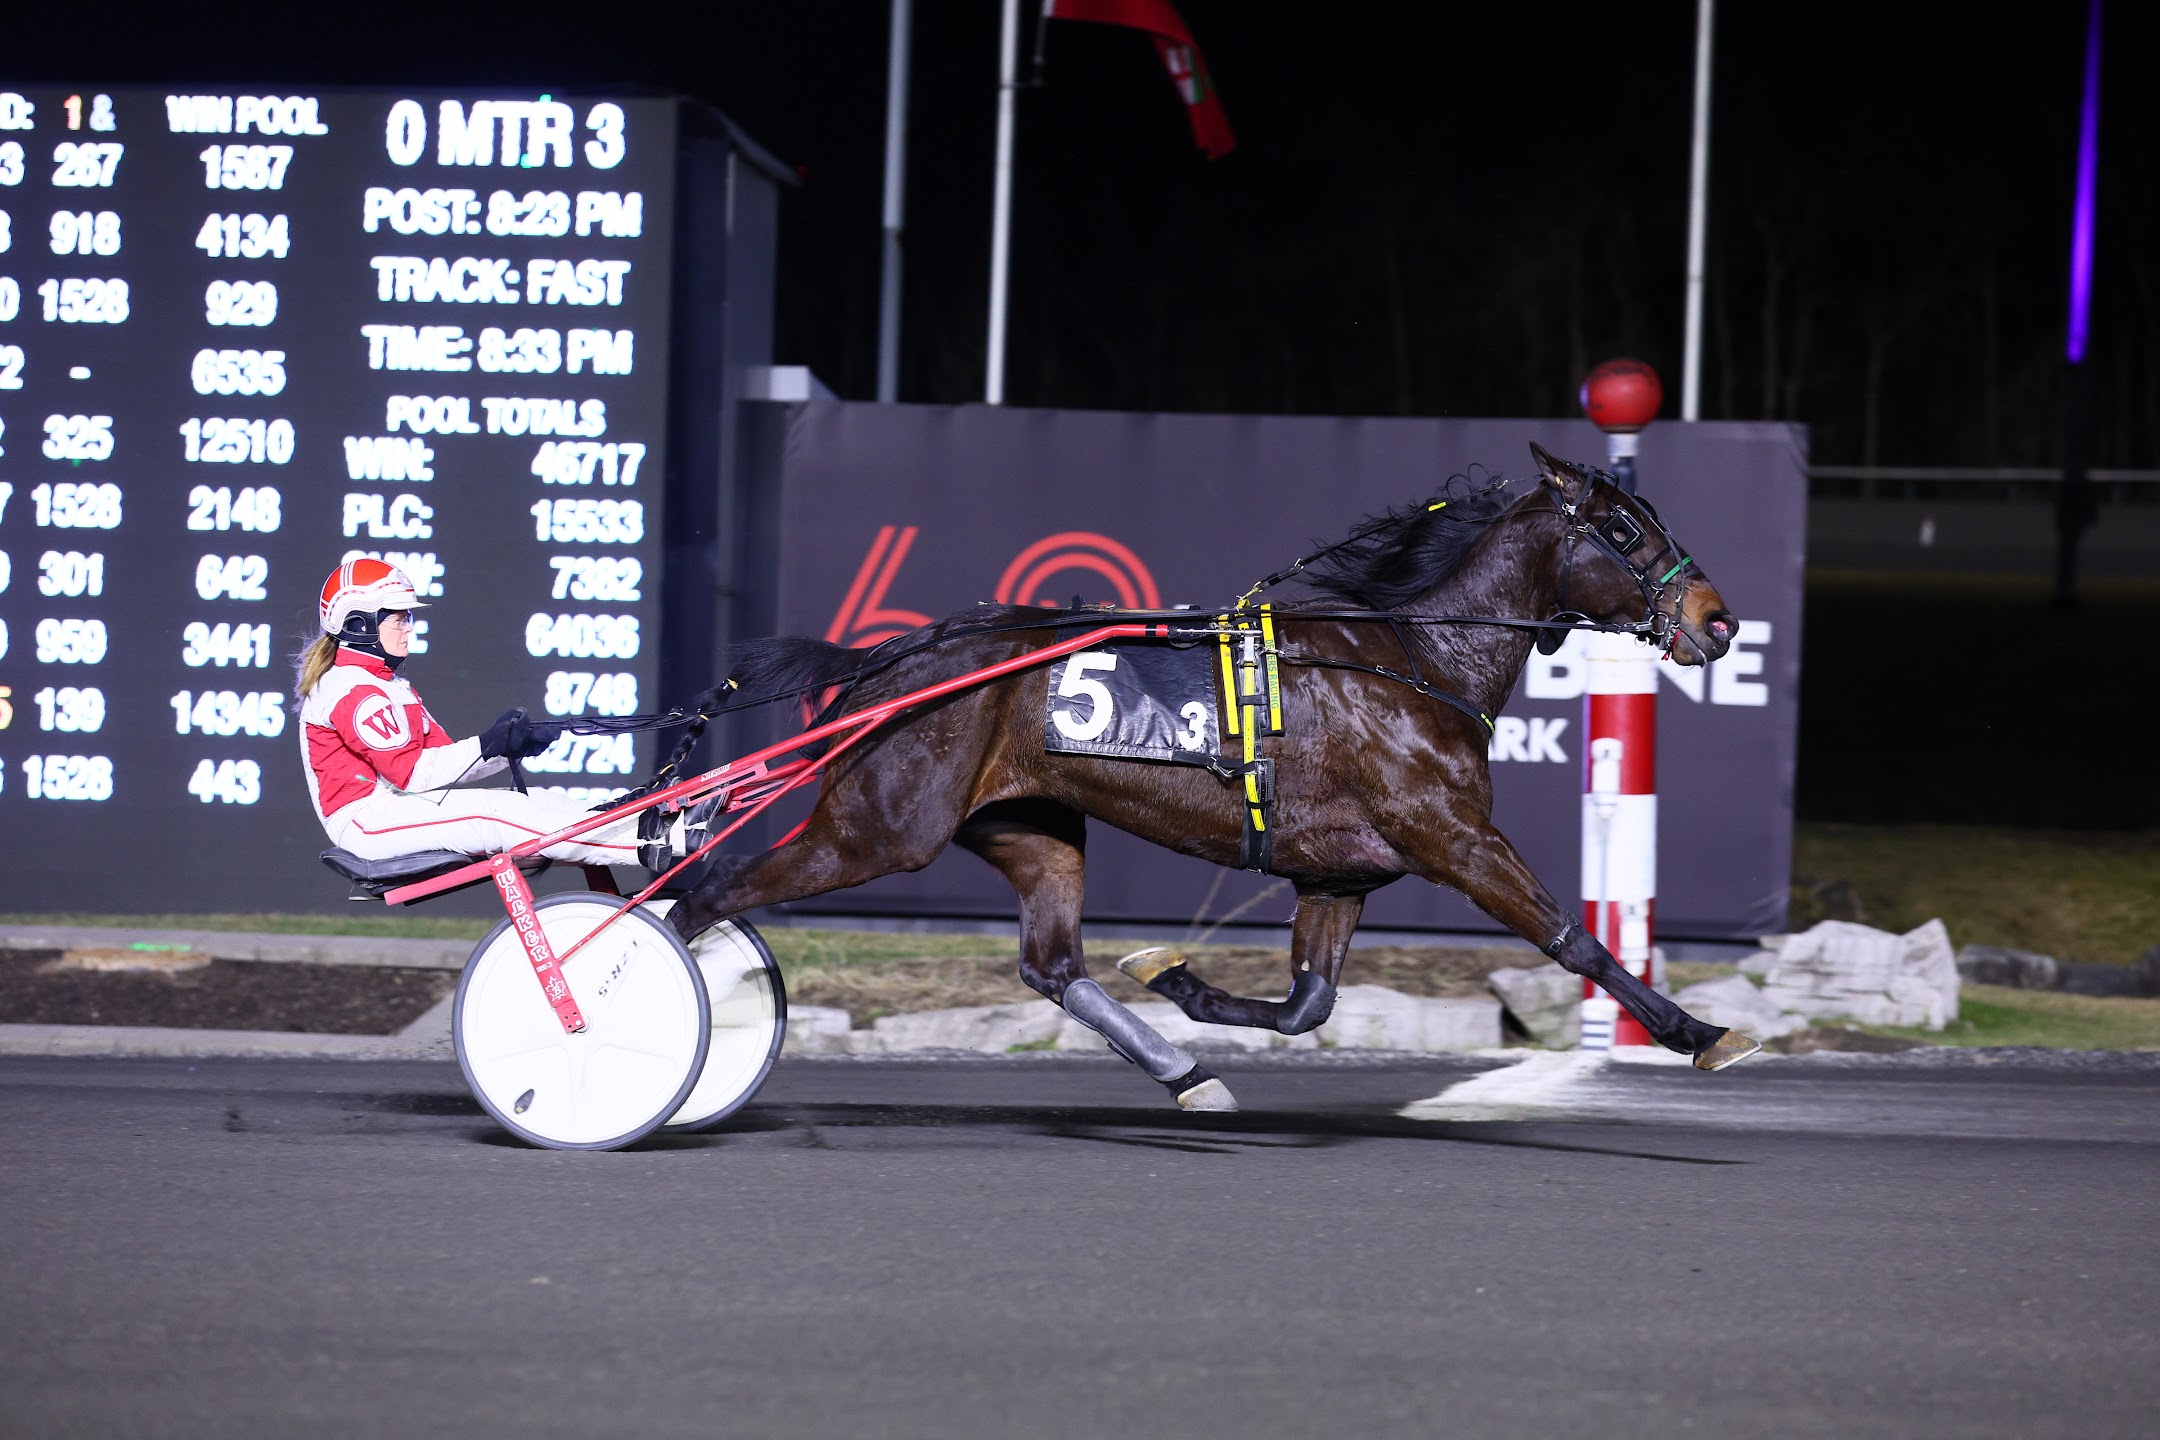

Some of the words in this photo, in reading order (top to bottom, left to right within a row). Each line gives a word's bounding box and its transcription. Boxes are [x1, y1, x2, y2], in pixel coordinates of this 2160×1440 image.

[65, 96, 81, 130] 1
[90, 95, 115, 131] &
[165, 95, 233, 133] WIN
[235, 96, 328, 135] POOL
[438, 99, 574, 168] MTR
[585, 103, 625, 169] 3
[52, 142, 124, 187] 267
[49, 211, 121, 255] 918
[363, 187, 481, 235] POST:
[486, 190, 571, 237] 8:23
[575, 191, 643, 237] PM
[195, 213, 290, 258] 4134
[38, 278, 129, 323] 1528
[205, 280, 278, 326] 929
[370, 256, 520, 304] TRACK:
[527, 259, 631, 306] FAST
[191, 349, 286, 396] 6535
[360, 324, 473, 371] TIME:
[477, 327, 562, 373] 8:33
[566, 329, 633, 375] PM
[42, 414, 114, 458] 325
[386, 395, 481, 434] POOL
[481, 397, 607, 437] TOTALS
[180, 417, 295, 464] 12510
[343, 436, 434, 481] WIN:
[531, 441, 646, 485] 46717
[31, 483, 122, 529] 1528
[187, 485, 281, 533] 2148
[343, 493, 434, 539] PLC:
[530, 499, 644, 544] 15533
[38, 551, 104, 597] 301
[195, 554, 268, 600] 642
[550, 556, 643, 601] 7382
[36, 618, 107, 664] 959
[183, 622, 271, 668] 3441
[525, 613, 640, 659] 64036
[34, 687, 105, 732] 139
[170, 690, 285, 737] 14345
[544, 671, 638, 716] 8748
[1051, 652, 1117, 740] 5
[1268, 673, 1280, 709] RACING
[362, 704, 401, 740] W
[1177, 701, 1207, 750] 3
[22, 755, 113, 801] 1528
[188, 759, 261, 805] 443
